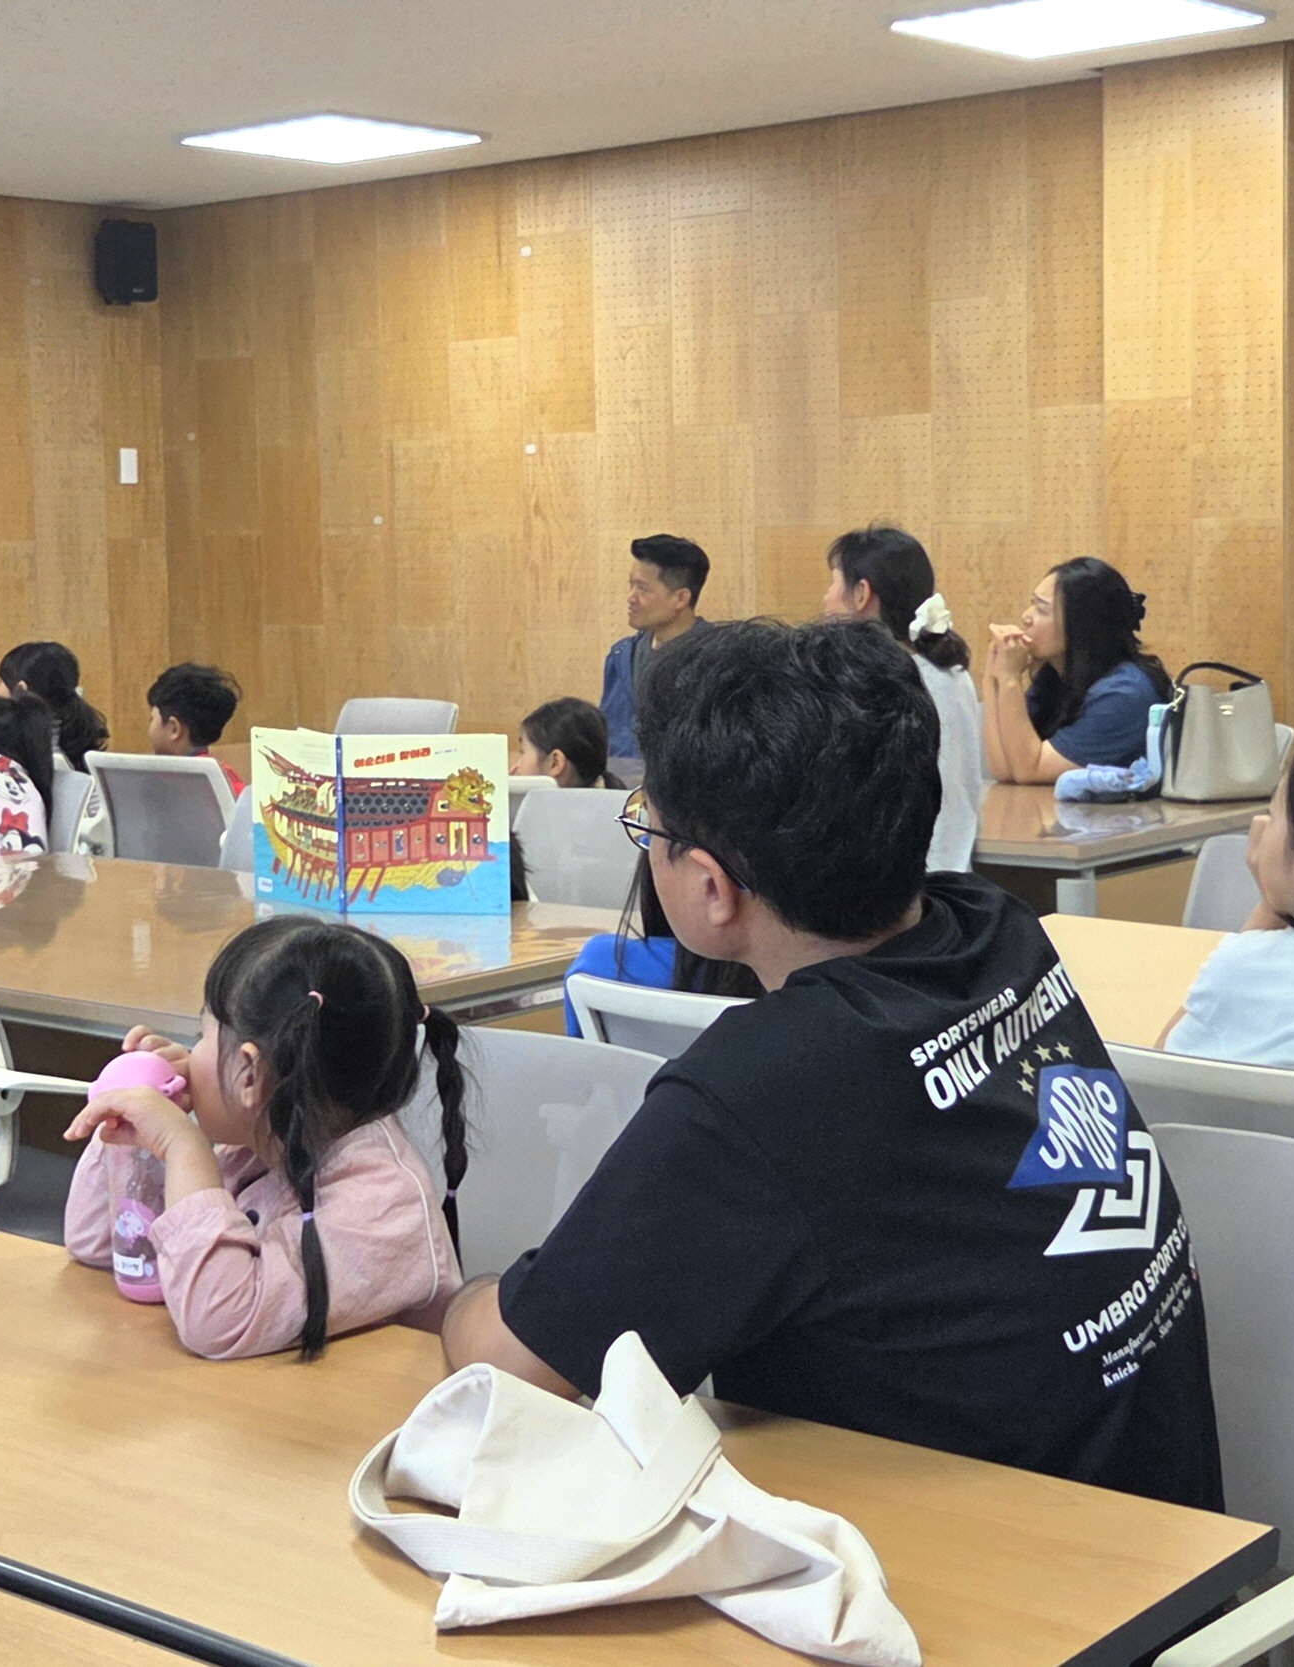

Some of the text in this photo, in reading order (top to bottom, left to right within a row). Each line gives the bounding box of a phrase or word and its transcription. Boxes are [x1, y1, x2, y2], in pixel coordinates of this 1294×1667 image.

[909, 987, 1018, 1068] SPORTSWEAR
[923, 1034, 992, 1111] ONLY
[1039, 1075, 1117, 1170] UMBRO
[1062, 1280, 1147, 1352] UMBRO
[1143, 1228, 1182, 1292] SPORTS
